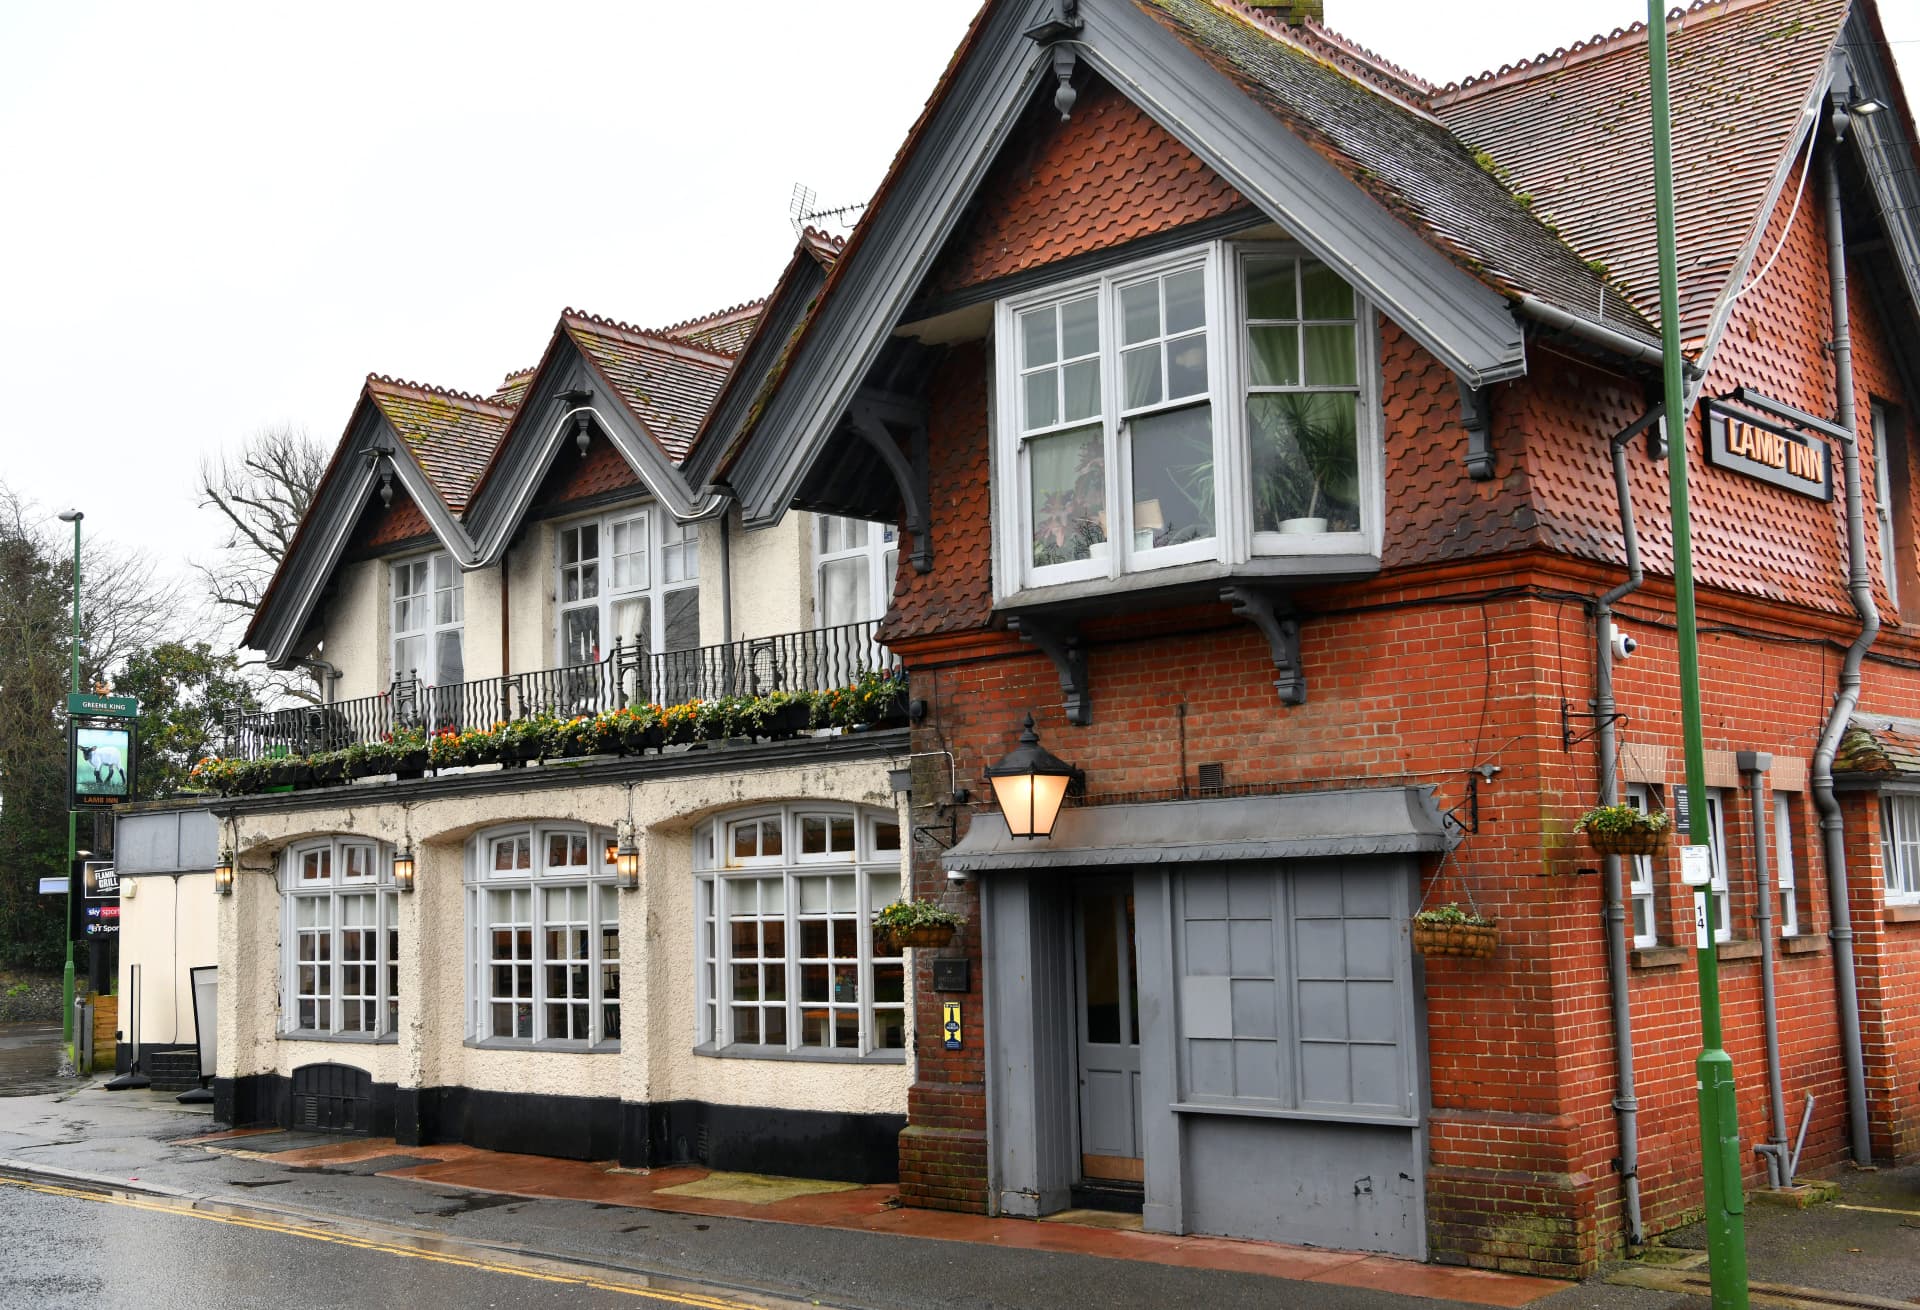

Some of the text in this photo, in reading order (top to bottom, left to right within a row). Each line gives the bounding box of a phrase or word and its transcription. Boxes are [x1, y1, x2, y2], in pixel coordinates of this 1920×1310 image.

[1725, 418, 1823, 484] LAMB INN
[82, 701, 107, 709] GREENE
[98, 878, 118, 888] GRILL
[88, 907, 101, 917] sky
